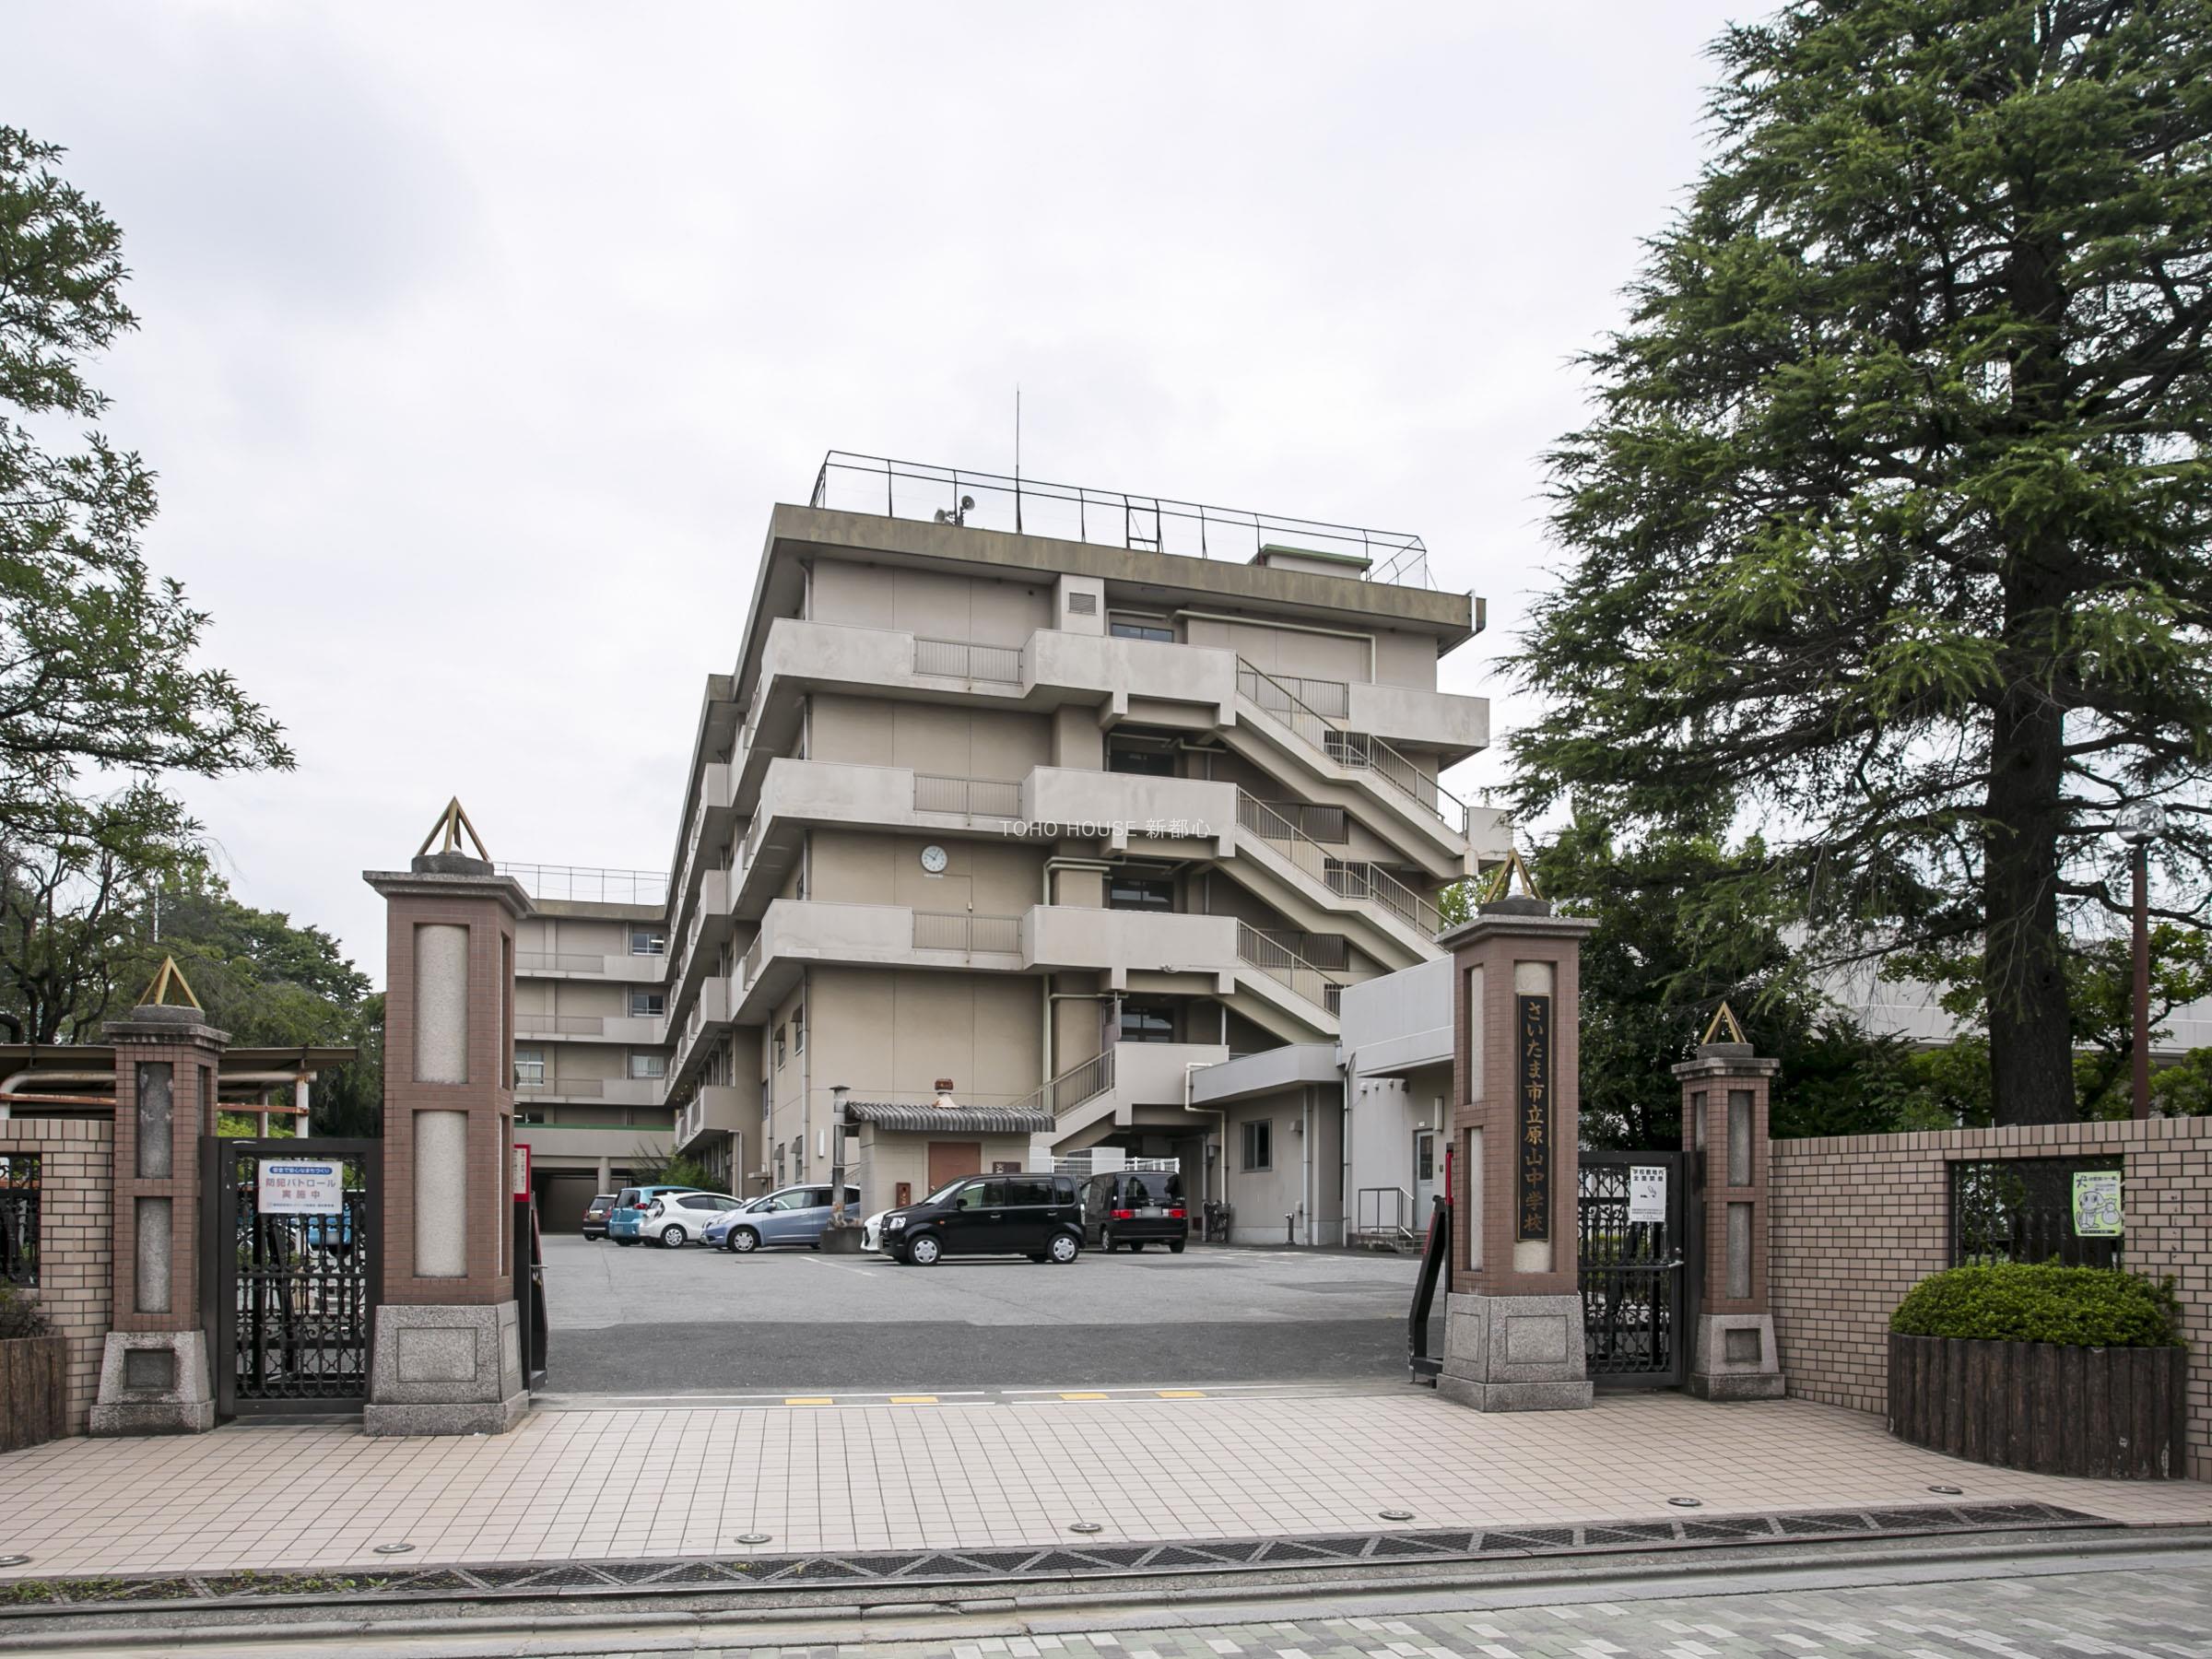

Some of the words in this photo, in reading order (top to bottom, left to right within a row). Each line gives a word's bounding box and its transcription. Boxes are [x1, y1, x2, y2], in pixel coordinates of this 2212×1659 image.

[1524, 1001, 1544, 1231] さいたま市立原山中学校
[265, 1178, 336, 1187] 防犯パトロール
[282, 1190, 321, 1198] 実施中
